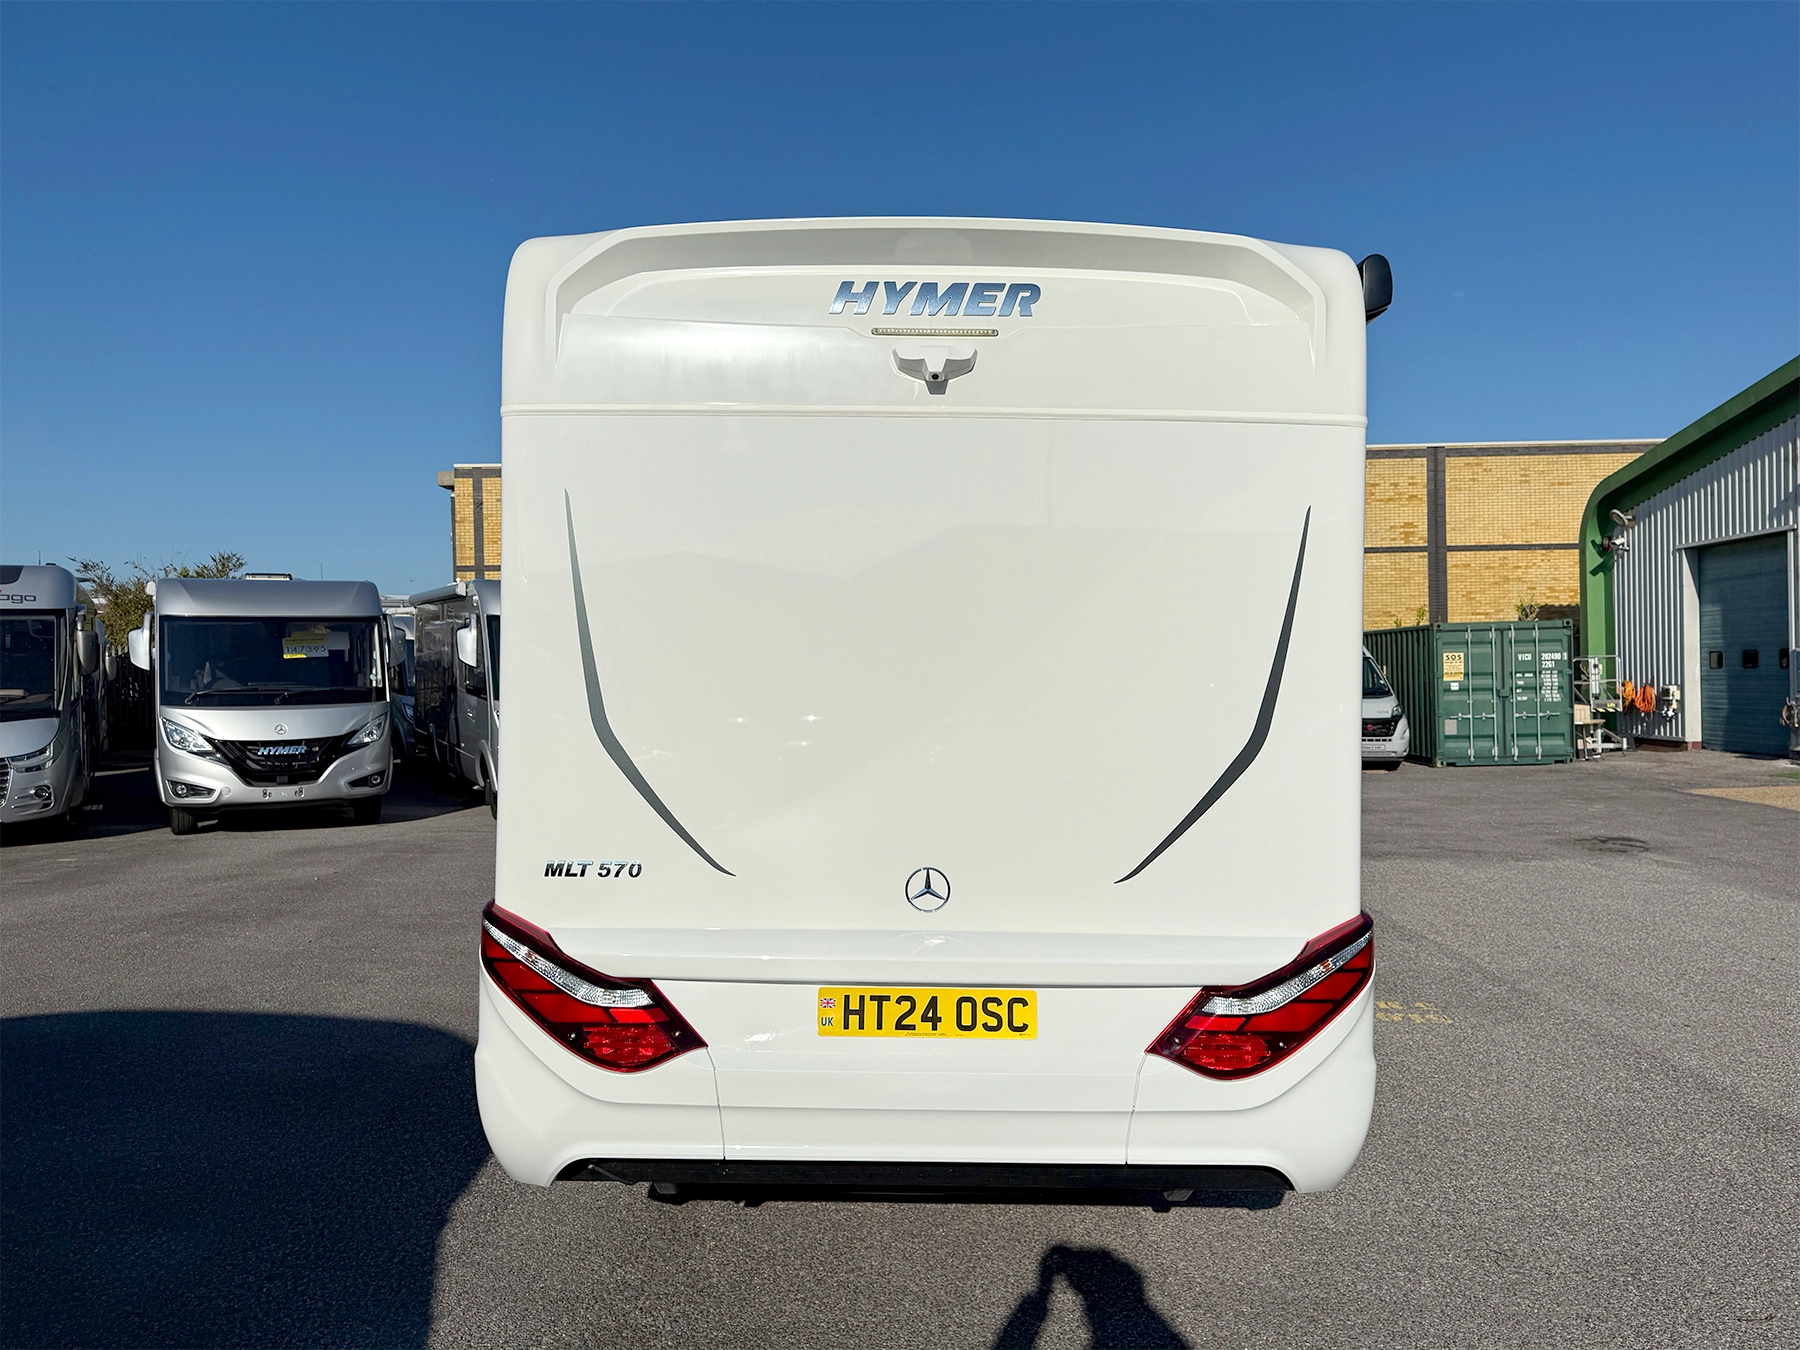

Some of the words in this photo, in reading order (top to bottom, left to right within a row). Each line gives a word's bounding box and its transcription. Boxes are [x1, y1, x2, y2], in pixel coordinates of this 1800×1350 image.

[829, 281, 1041, 317] HYMER
[286, 645, 327, 654] 147395
[1517, 653, 1532, 661] VICU
[257, 745, 307, 756] HYMER
[543, 860, 594, 877] MLT
[597, 860, 643, 878] 570
[843, 994, 942, 1031] HT24
[956, 996, 1029, 1032] OSC
[821, 1017, 834, 1027] UK
